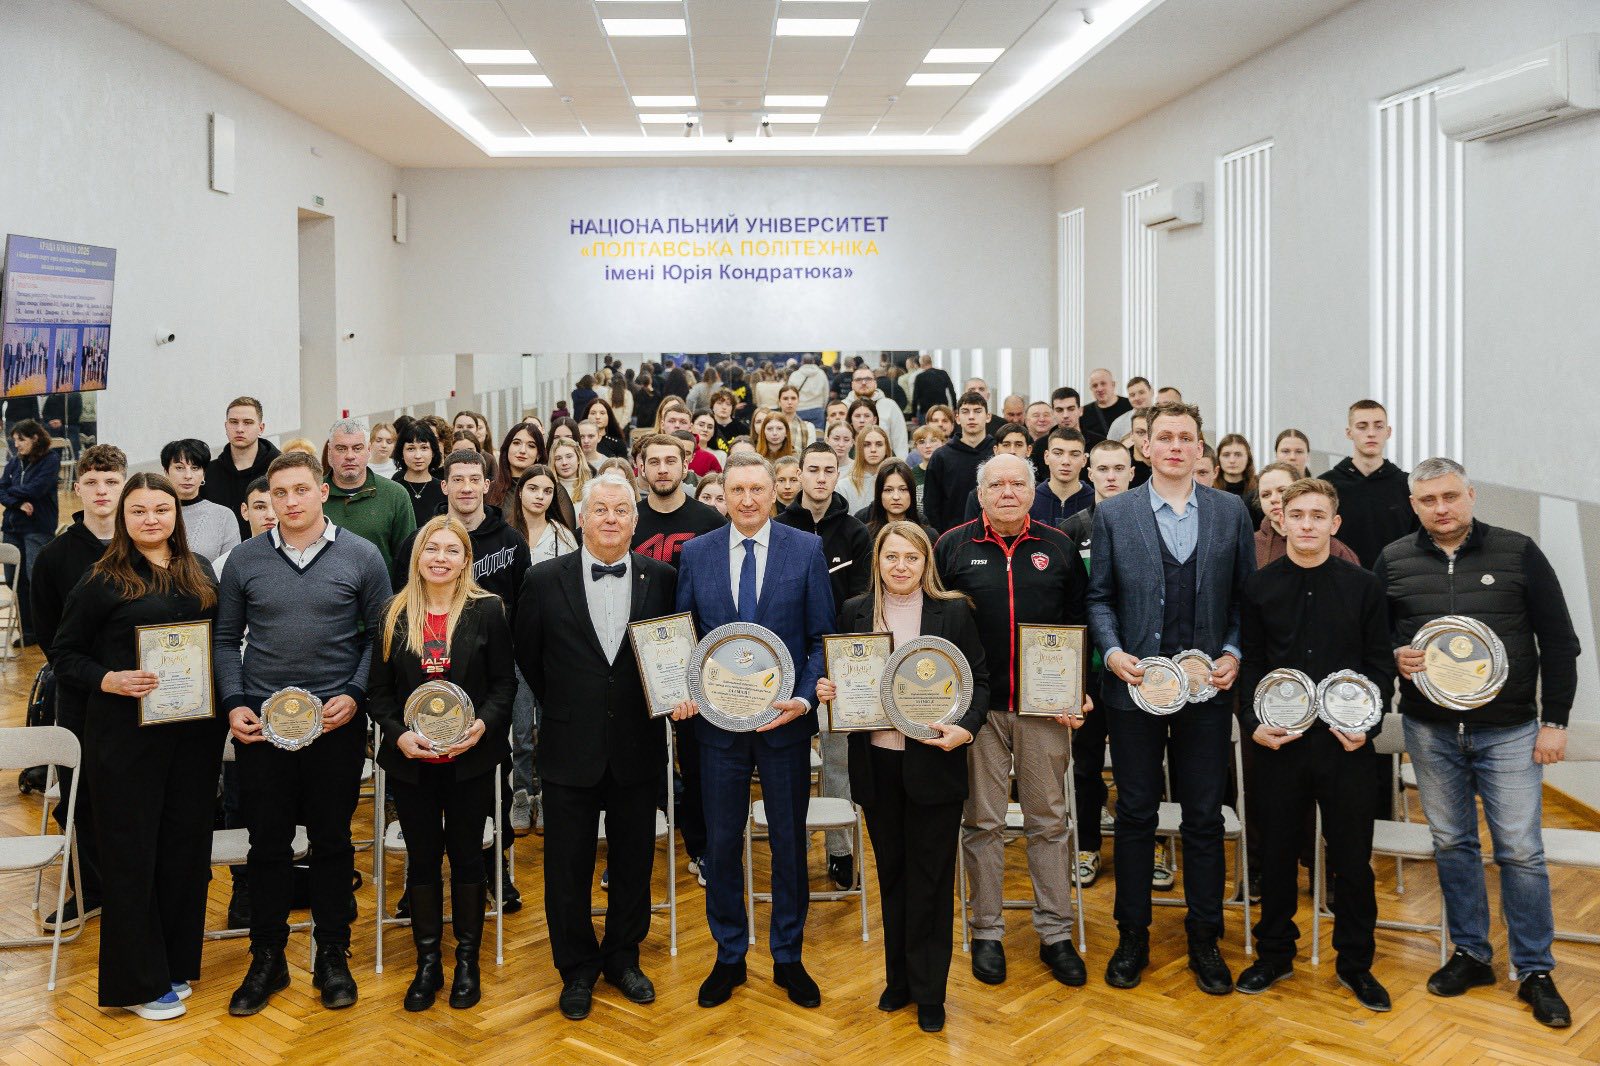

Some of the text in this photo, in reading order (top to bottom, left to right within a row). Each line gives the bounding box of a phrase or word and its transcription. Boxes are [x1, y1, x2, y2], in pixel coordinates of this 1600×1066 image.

[570, 214, 889, 236] НАЦІОНАЛЬНИЙ УНІВЕРСИТЕТ
[581, 239, 880, 257] «ПОЛТАВСЬКА ПОЛІТЕХНІКА
[605, 263, 853, 284] імені Юрія Кондратюка»
[426, 665, 444, 673] 25
